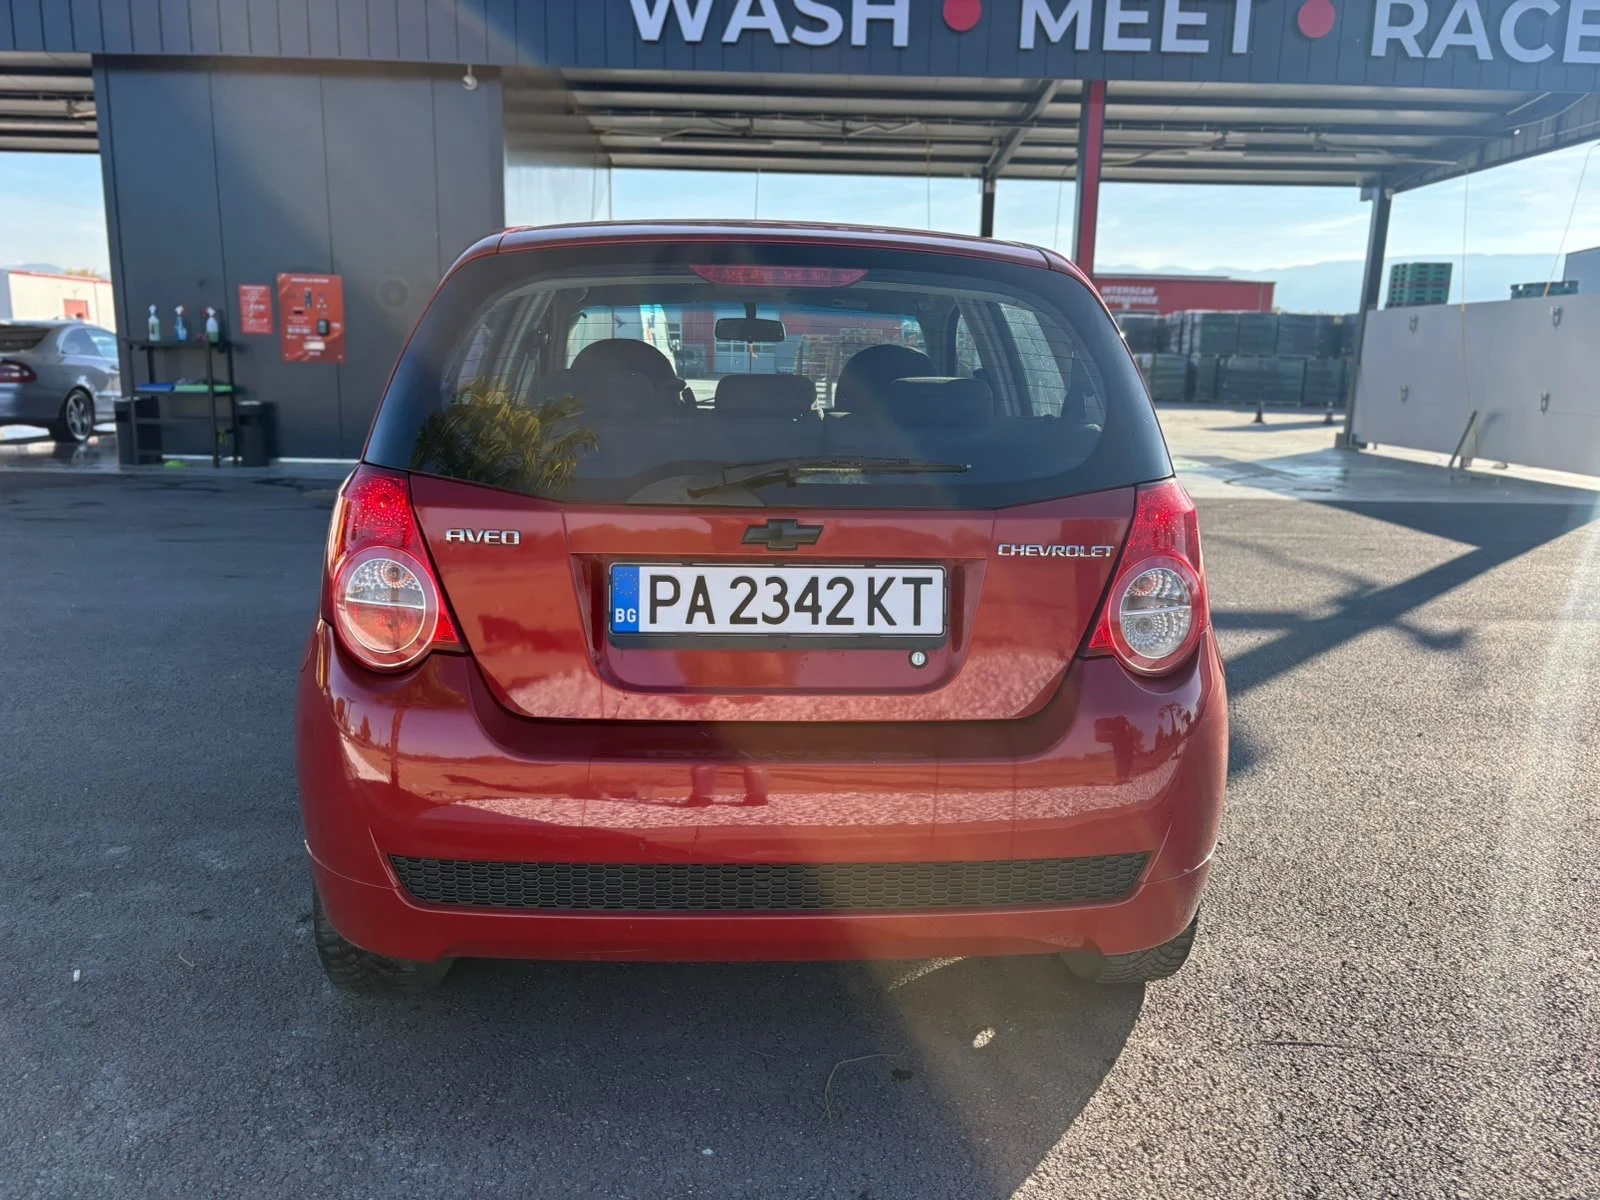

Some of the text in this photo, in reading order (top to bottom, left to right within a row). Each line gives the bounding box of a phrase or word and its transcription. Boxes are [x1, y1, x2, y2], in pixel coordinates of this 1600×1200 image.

[629, 0, 910, 47] WASH
[1371, 0, 1600, 63] RACE
[445, 528, 520, 545] AVEO
[997, 543, 1114, 557] CHEVROLET
[649, 574, 933, 626] PA 2342 KT
[615, 608, 637, 623] BG
